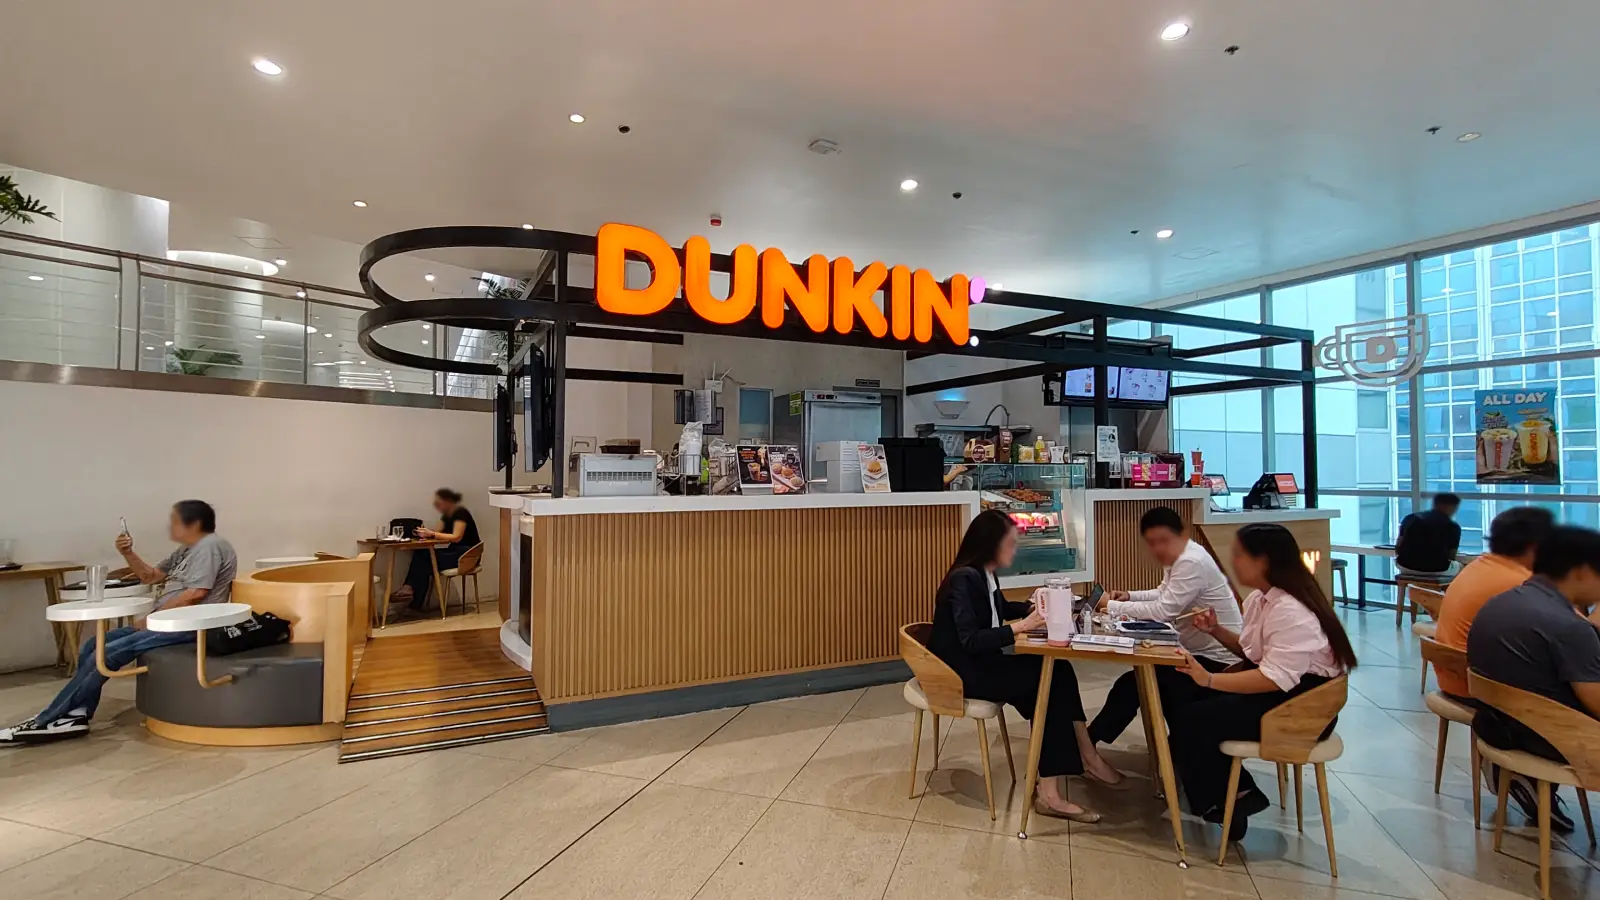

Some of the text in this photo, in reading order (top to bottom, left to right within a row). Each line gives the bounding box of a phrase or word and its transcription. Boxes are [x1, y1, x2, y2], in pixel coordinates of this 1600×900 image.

[595, 222, 986, 346] DUNKIN'
[1483, 391, 1547, 406] ALL DAY
